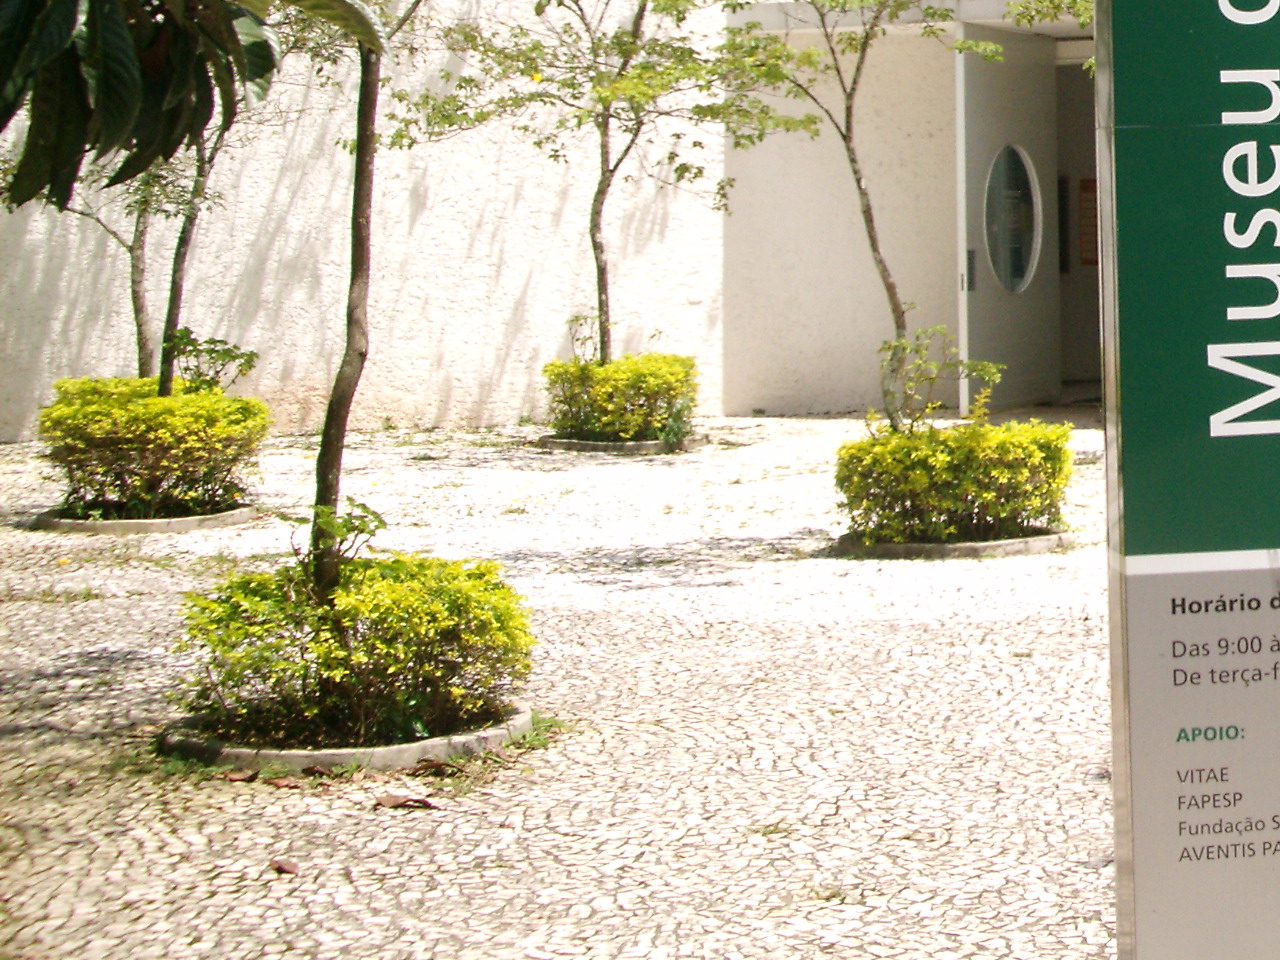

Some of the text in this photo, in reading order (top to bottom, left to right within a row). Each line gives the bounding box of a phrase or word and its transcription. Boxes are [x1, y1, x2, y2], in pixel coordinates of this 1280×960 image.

[1171, 593, 1262, 615] Horário
[1172, 640, 1210, 658] Das
[1218, 636, 1262, 656] 9:00
[1173, 669, 1201, 686] De
[1176, 725, 1245, 742] APOIO:
[1176, 767, 1229, 784] VITAE
[1177, 792, 1243, 810] FAPESP
[1178, 817, 1266, 837] Fundação
[1178, 842, 1256, 862] AVENTIS
